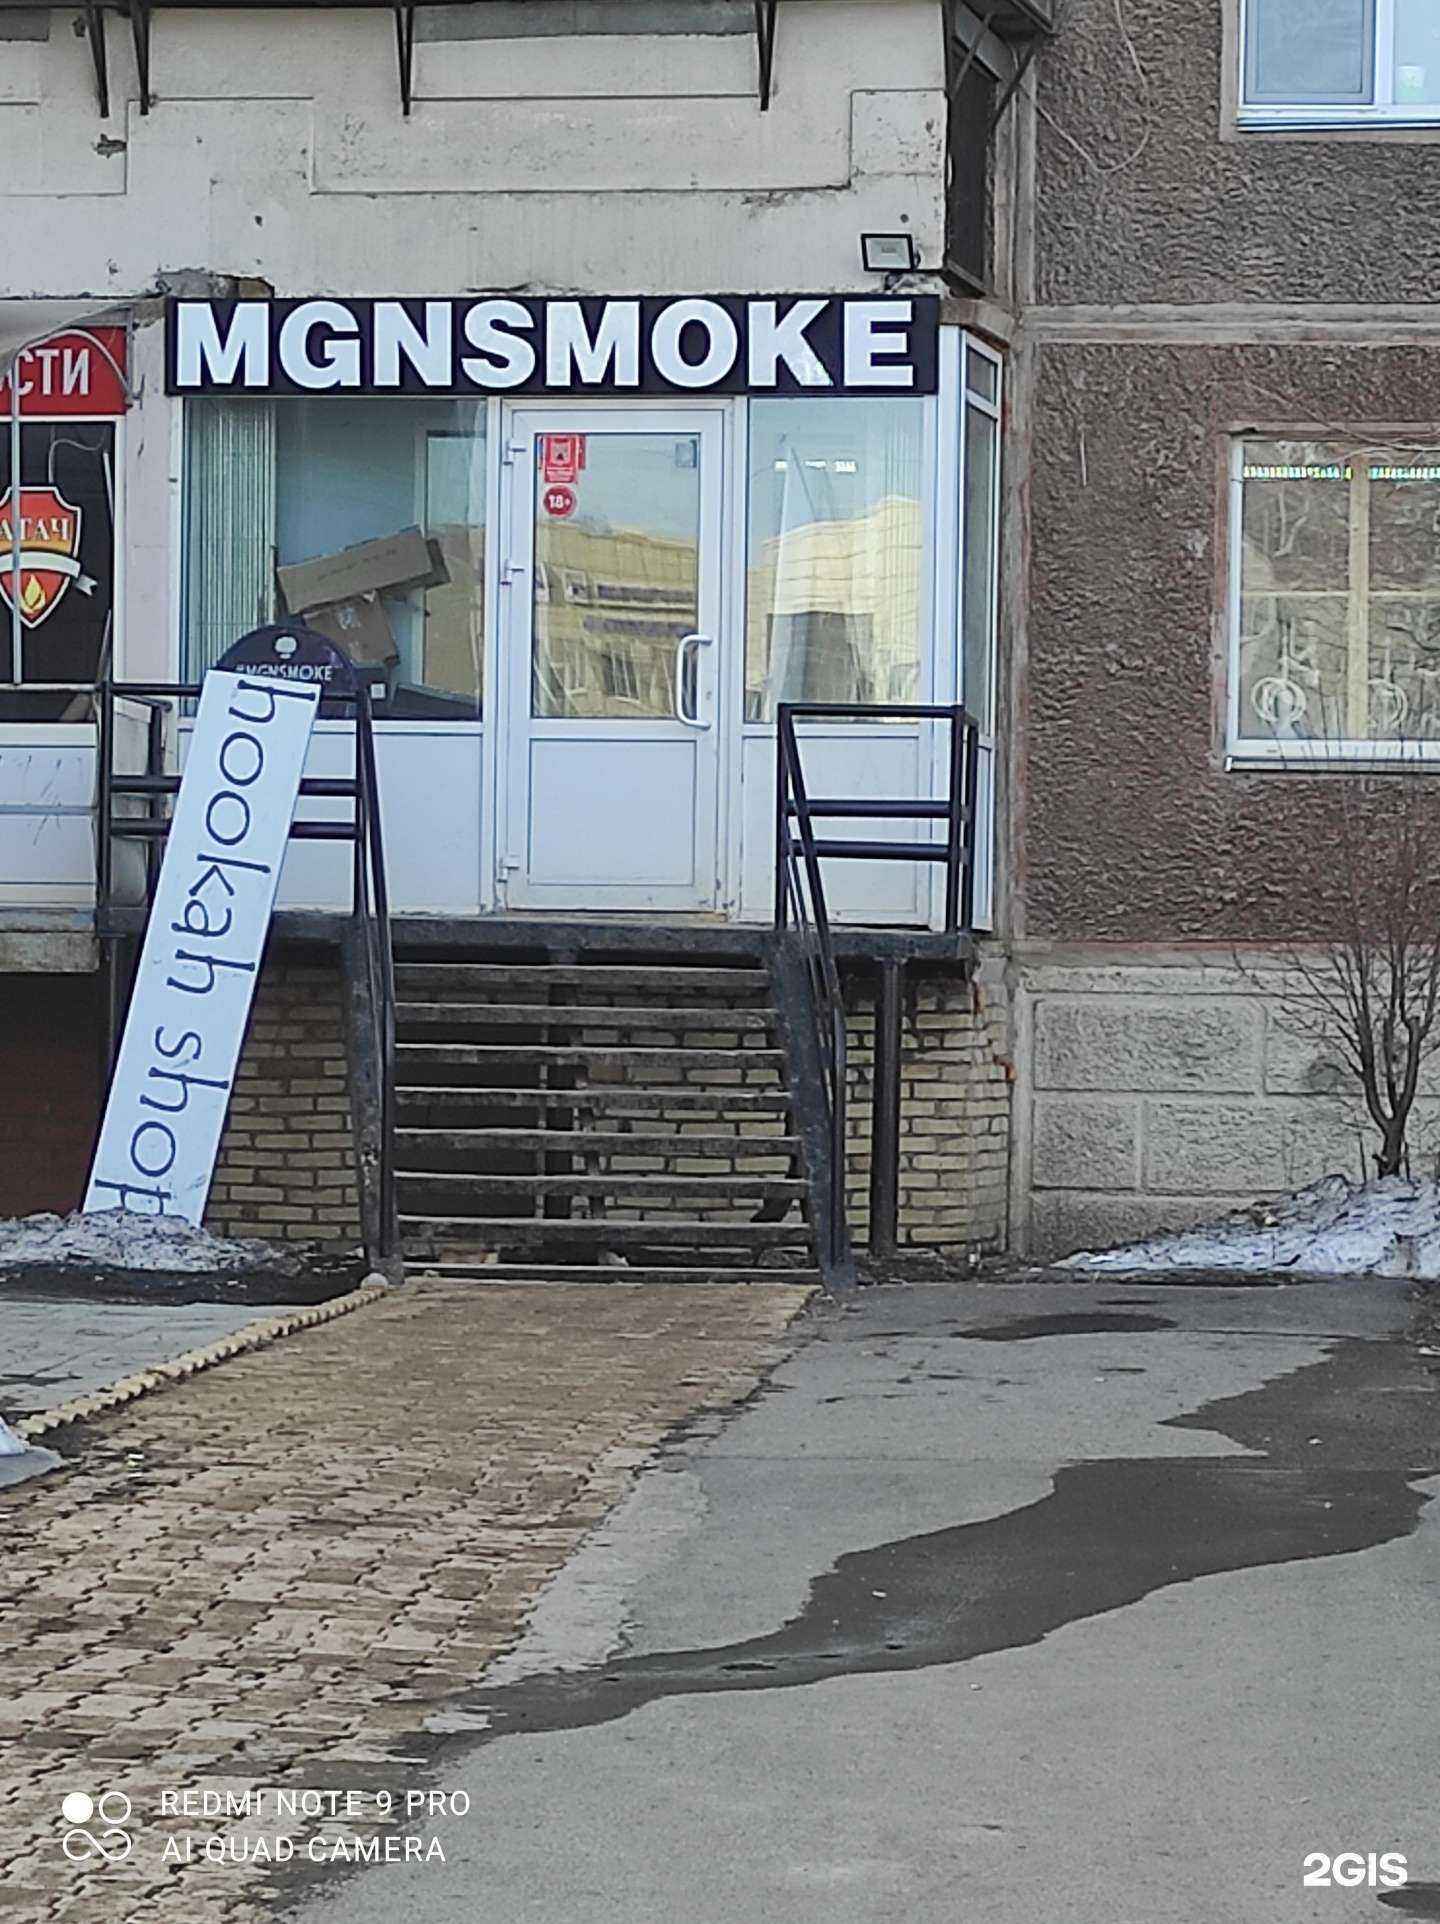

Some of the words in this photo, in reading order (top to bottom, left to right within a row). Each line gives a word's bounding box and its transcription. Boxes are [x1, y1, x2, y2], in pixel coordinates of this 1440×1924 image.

[0, 347, 89, 396] СТИ
[176, 299, 914, 389] MGNSMOKE
[548, 494, 571, 509] 18+
[166, 679, 317, 995] hookah
[94, 1025, 230, 1214] shop
